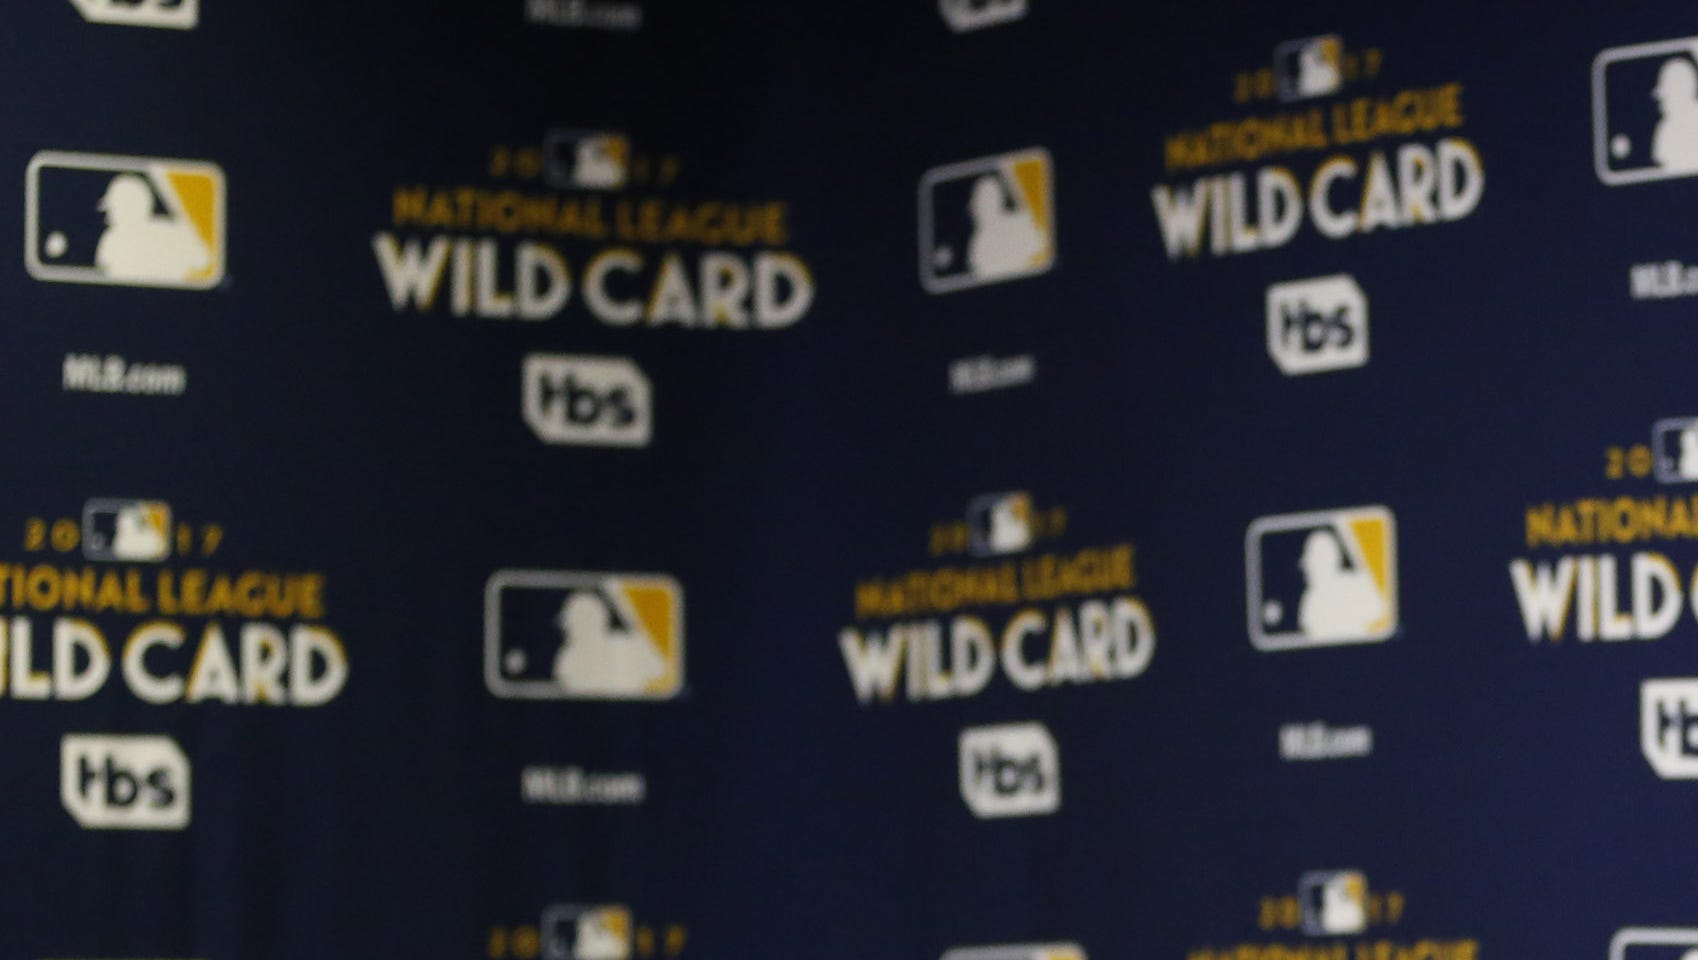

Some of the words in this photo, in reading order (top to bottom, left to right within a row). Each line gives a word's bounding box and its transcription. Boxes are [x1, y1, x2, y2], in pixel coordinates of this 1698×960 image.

[394, 189, 604, 241] NATIONAL
[617, 202, 789, 247] LEAGUE
[1152, 167, 1303, 259] WILD
[1310, 137, 1485, 239] CARD
[373, 230, 573, 320] WILD
[584, 252, 815, 330] CARD
[0, 562, 149, 615] TIONAL
[157, 568, 325, 619] LEAGUE
[1510, 550, 1684, 643] WILD
[0, 615, 113, 702] LD
[122, 619, 348, 706] CARD
[838, 614, 996, 704] WILD
[1001, 597, 1156, 690] CARD
[79, 753, 174, 810] tbs
